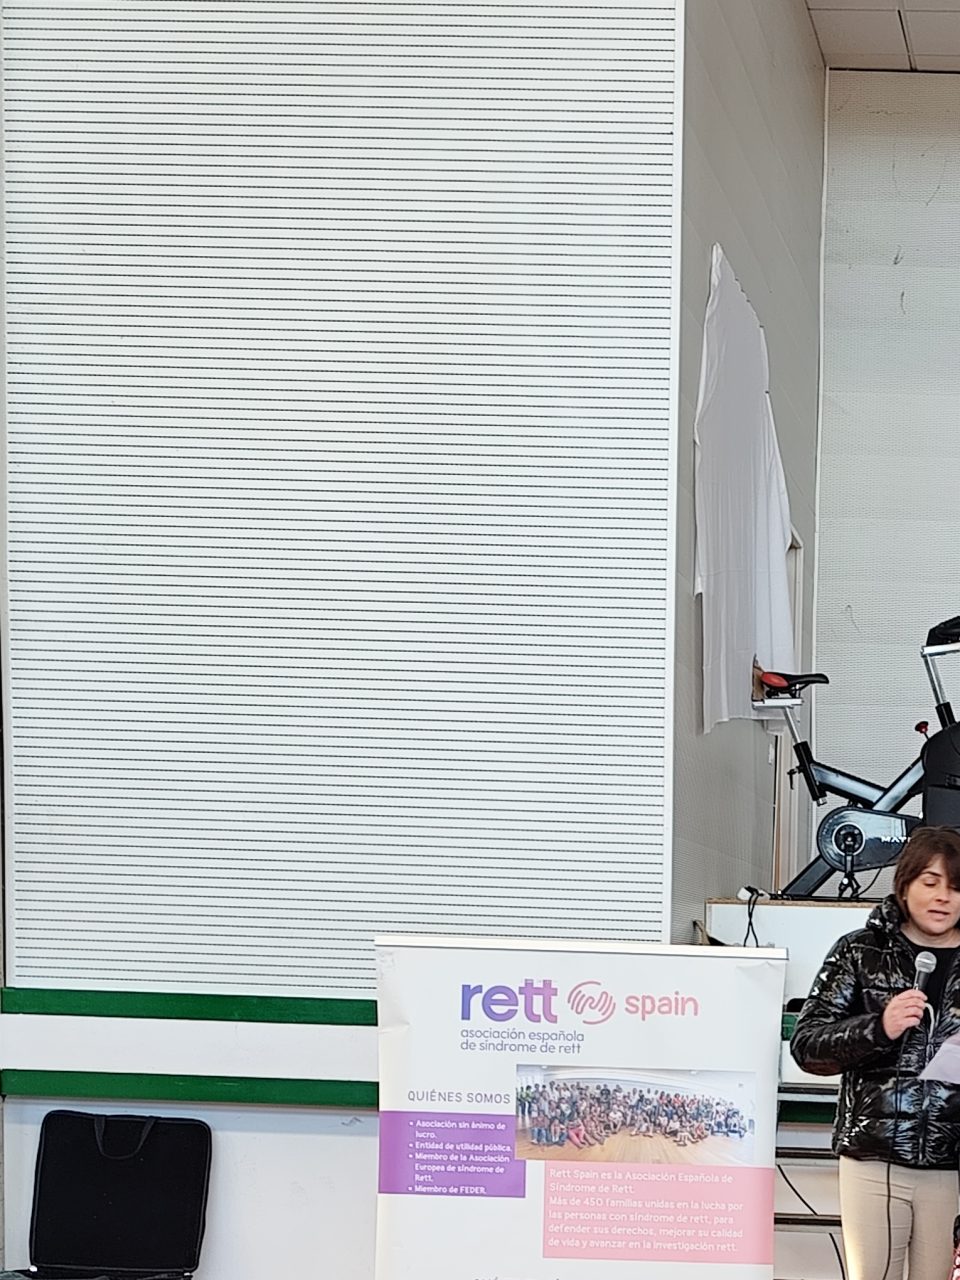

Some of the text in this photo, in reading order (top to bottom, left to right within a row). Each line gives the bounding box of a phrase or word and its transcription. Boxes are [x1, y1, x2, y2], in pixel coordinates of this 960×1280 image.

[461, 979, 698, 1024] rett spain
[461, 1026, 584, 1042] asociación española
[461, 1040, 476, 1050] de
[540, 1042, 556, 1053] de
[559, 1043, 580, 1054] rett
[408, 1089, 511, 1104] QUIÉNES SOMOS
[416, 1120, 457, 1129] Asociación
[469, 1154, 510, 1162] Asociación
[549, 1169, 571, 1178] Rett
[574, 1169, 598, 1180] Spain
[614, 1170, 623, 1180] la
[625, 1170, 676, 1181] Asociación
[678, 1172, 720, 1183] Española
[722, 1174, 733, 1183] de
[599, 1184, 609, 1193] de
[570, 1197, 581, 1206] de
[584, 1197, 602, 1207] 450
[677, 1201, 687, 1209] en
[690, 1200, 699, 1209] la
[677, 1214, 688, 1223] de
[549, 1238, 560, 1247] de
